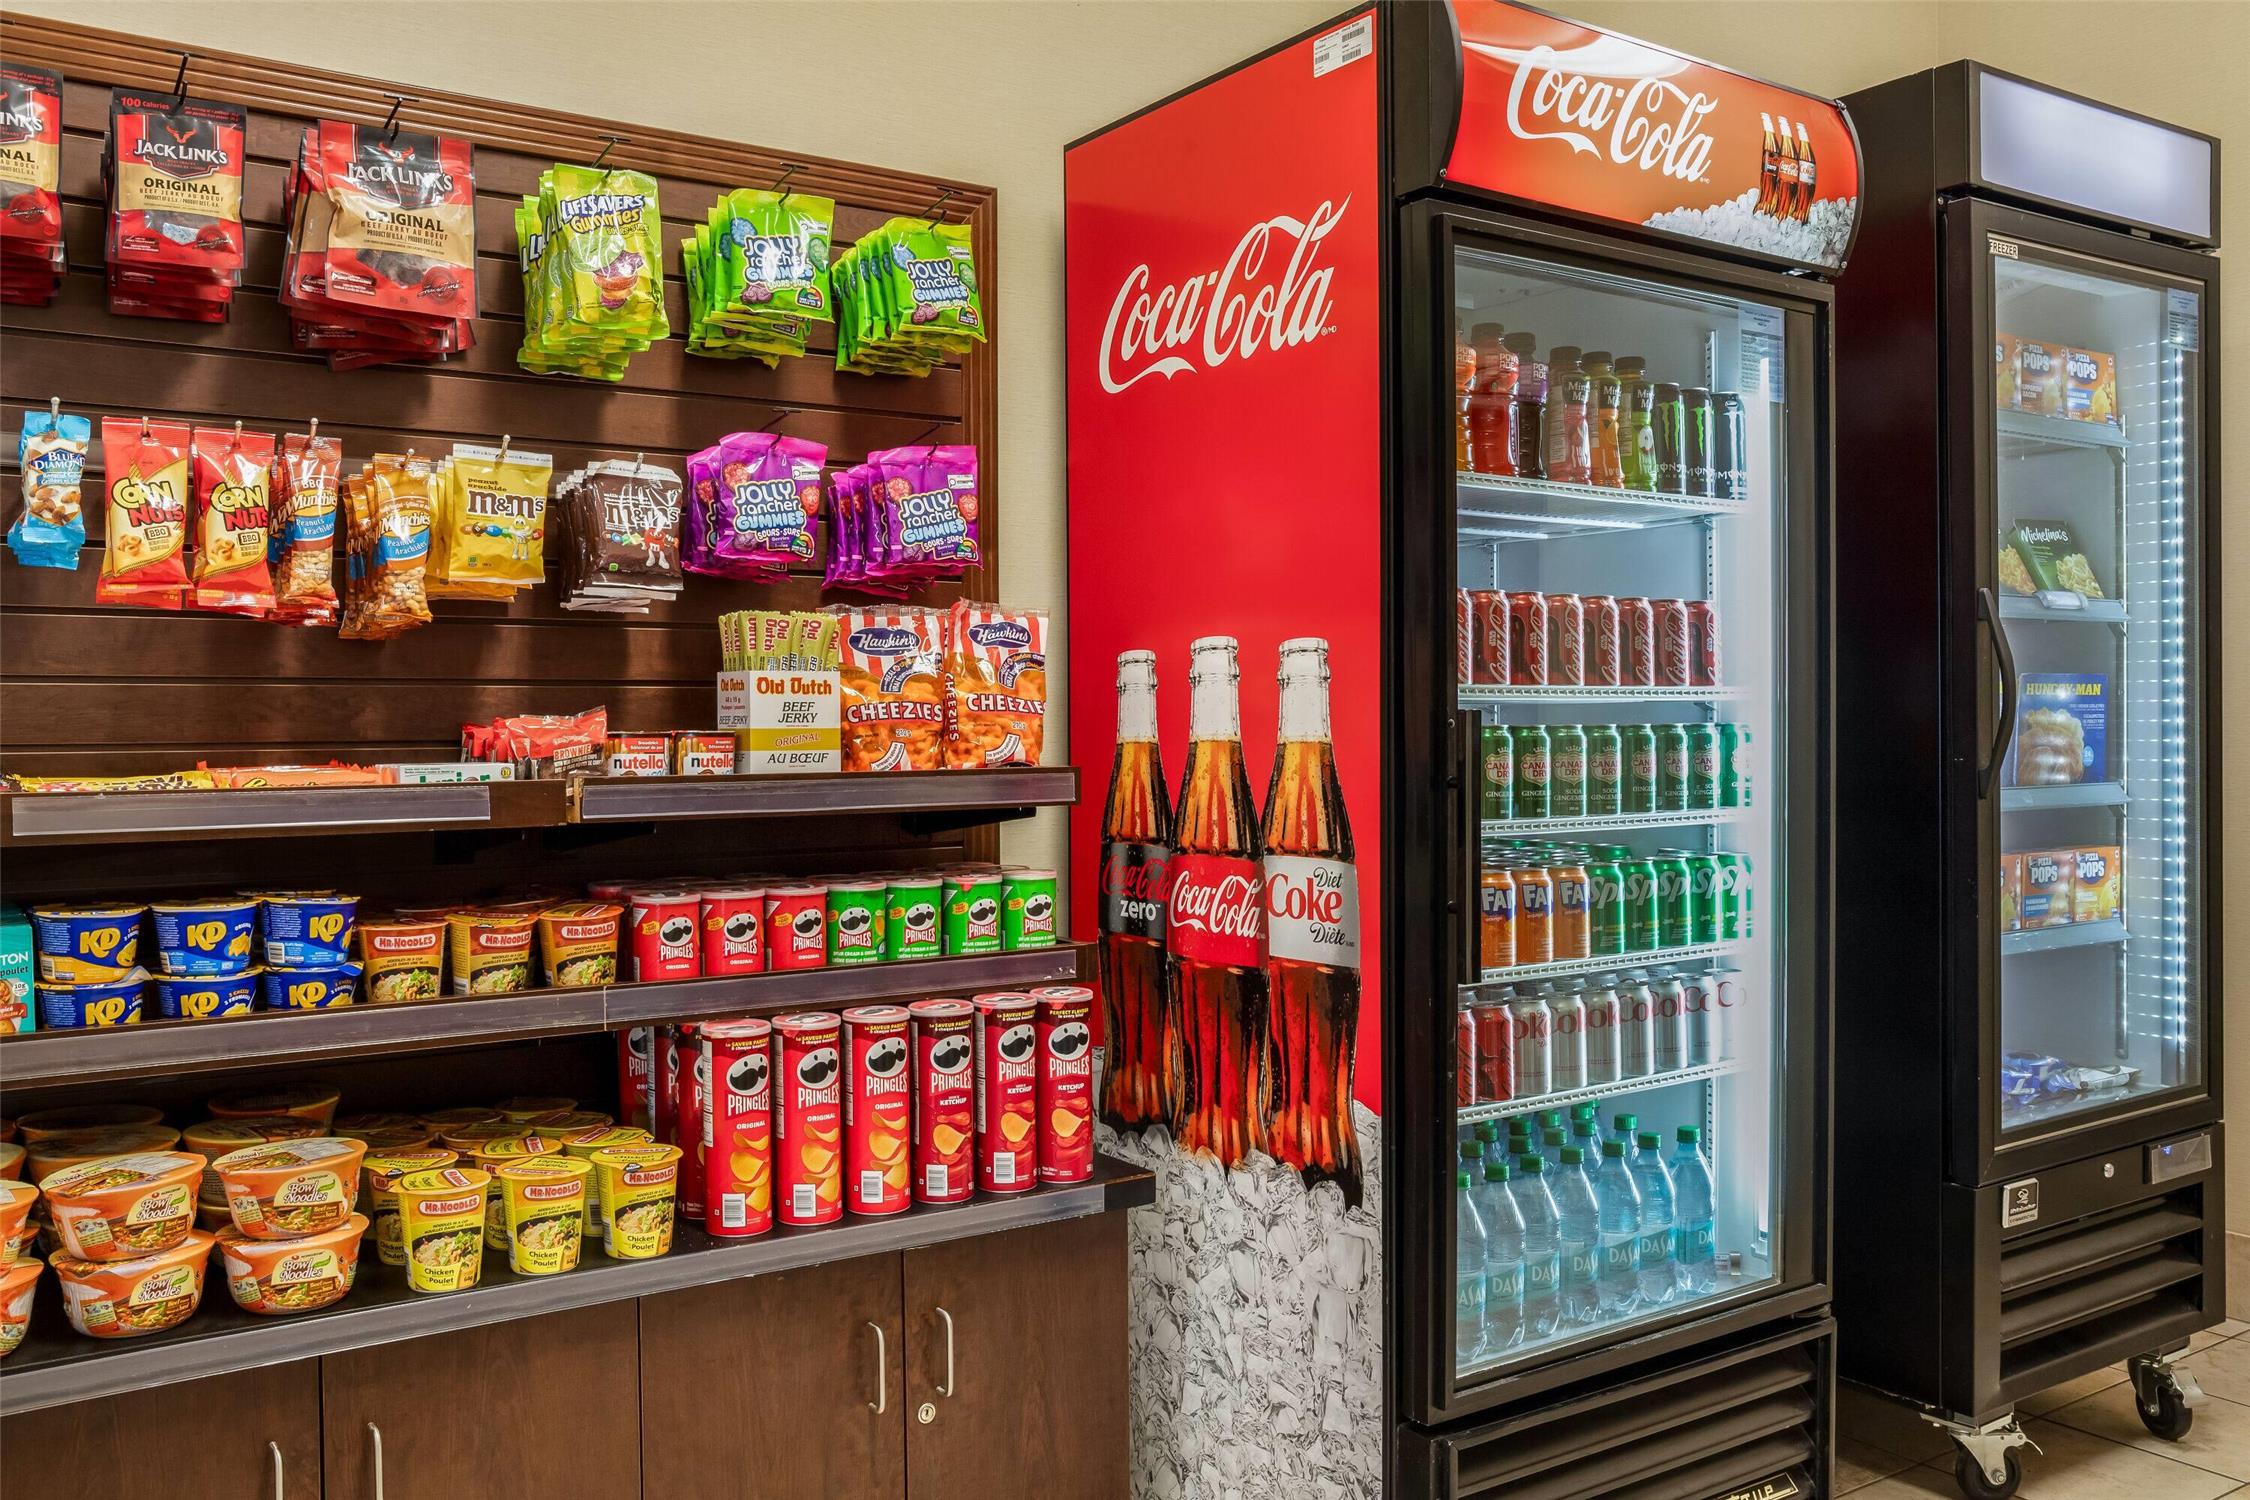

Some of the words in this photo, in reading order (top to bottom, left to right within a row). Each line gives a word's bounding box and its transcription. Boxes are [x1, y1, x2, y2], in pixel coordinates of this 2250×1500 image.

[121, 97, 141, 108] 100
[0, 112, 43, 131] INK'S
[1506, 45, 1718, 183] Coca-Cola
[134, 139, 178, 160] JACK
[179, 145, 228, 165] LINK'S
[347, 163, 393, 184] JACK
[143, 177, 220, 195] ORIGINAL
[561, 195, 645, 224] LIFESAVERS
[385, 223, 410, 234] JERKY
[412, 228, 422, 236] AU
[424, 230, 448, 241] BOEUF
[1989, 241, 2018, 256] FREEZER
[909, 261, 952, 279] JOLLY
[915, 275, 960, 288] rancher
[913, 286, 968, 301] GUMMIES
[1099, 192, 1352, 393] Coca-Cola
[2023, 352, 2050, 371] POPS
[2070, 361, 2097, 380] POPS
[48, 452, 76, 462] BLUE
[468, 477, 499, 485] peanut
[112, 477, 175, 509] CORN
[211, 482, 265, 512] CORN
[736, 482, 795, 505] JOLLY
[739, 499, 800, 516] rancher
[901, 491, 951, 518] JOLLY
[129, 502, 185, 528] NUTS
[223, 507, 269, 531] NUTS
[382, 512, 431, 533] Mnchies
[736, 511, 805, 530] GUMMIES
[906, 511, 957, 529] rancher
[149, 528, 167, 538] BBQ
[902, 521, 964, 545] GUMMIES
[2021, 525, 2069, 545] Michelina's
[777, 618, 790, 641] Old
[807, 619, 822, 641] Old
[978, 627, 1028, 643] Hawkins
[858, 632, 917, 651] Hawkins
[756, 676, 785, 695] Old
[790, 677, 832, 695] Dutch
[782, 701, 815, 712] BEEF
[847, 701, 943, 724] CHEEZIES
[944, 672, 960, 741] CHEEZIES
[719, 715, 731, 725] BEEF
[731, 715, 748, 725] JERKY
[778, 712, 818, 724] JERKY
[775, 733, 820, 747] ORIGINAL
[554, 744, 592, 761] BROWNIE
[767, 753, 786, 764] AU
[613, 755, 664, 770] nutella
[691, 755, 735, 769] nutella
[1485, 762, 1510, 770] CANA
[1521, 762, 1547, 770] CANA
[1313, 866, 1344, 889] Diet
[2031, 865, 2058, 883] POPS
[2080, 860, 2105, 879] POPS
[1171, 870, 1264, 939] Coca-Cola
[1267, 872, 1343, 925] Coke
[1120, 898, 1156, 921] zero
[968, 921, 997, 938] PRINGLES
[1024, 916, 1053, 933] PRINGLES
[793, 933, 823, 951] PRINGLES
[839, 931, 872, 948] PRINGLES
[905, 927, 936, 943] PRINGLES
[1309, 922, 1346, 947] Diète
[660, 942, 694, 961] PRINGLES
[724, 938, 757, 956] PRINGLES
[0, 951, 29, 966] TON
[0, 965, 29, 978] poulet
[999, 1056, 1035, 1082] PRINGLES
[1049, 1055, 1089, 1079] PRINGLES
[866, 1071, 907, 1097] PRINGLES
[931, 1067, 972, 1093] PRINGLES
[1057, 1082, 1085, 1091] KETCHUP
[798, 1082, 839, 1109] PRINGLES
[1007, 1085, 1032, 1094] KETCHUP
[728, 1088, 769, 1117] PRINGLES
[874, 1101, 904, 1110] ORIGINAL
[939, 1097, 967, 1106] KETCHUP
[736, 1119, 766, 1130] ORIGINAL
[806, 1113, 836, 1122] ORIGINAL
[644, 1168, 674, 1183] NOODLES
[288, 1181, 319, 1194] Bowl
[545, 1183, 580, 1197] NOODLES
[141, 1194, 172, 1210] Bowl
[284, 1192, 328, 1204] Noodles
[440, 1198, 478, 1212] NOODLES
[136, 1206, 180, 1220] Noodles
[627, 1235, 655, 1243] Chicken
[631, 1243, 654, 1251] Poulet
[529, 1251, 558, 1259] Chicken
[1609, 1242, 1640, 1266] DASA
[282, 1258, 314, 1271] Bowl
[424, 1267, 455, 1276] Chicken
[533, 1259, 557, 1267] Poulet
[143, 1275, 174, 1290] Bowl
[280, 1267, 323, 1281] Noodles
[429, 1276, 454, 1285] Poulet
[138, 1286, 181, 1301] Noodles
[1492, 1275, 1525, 1295] DASA
